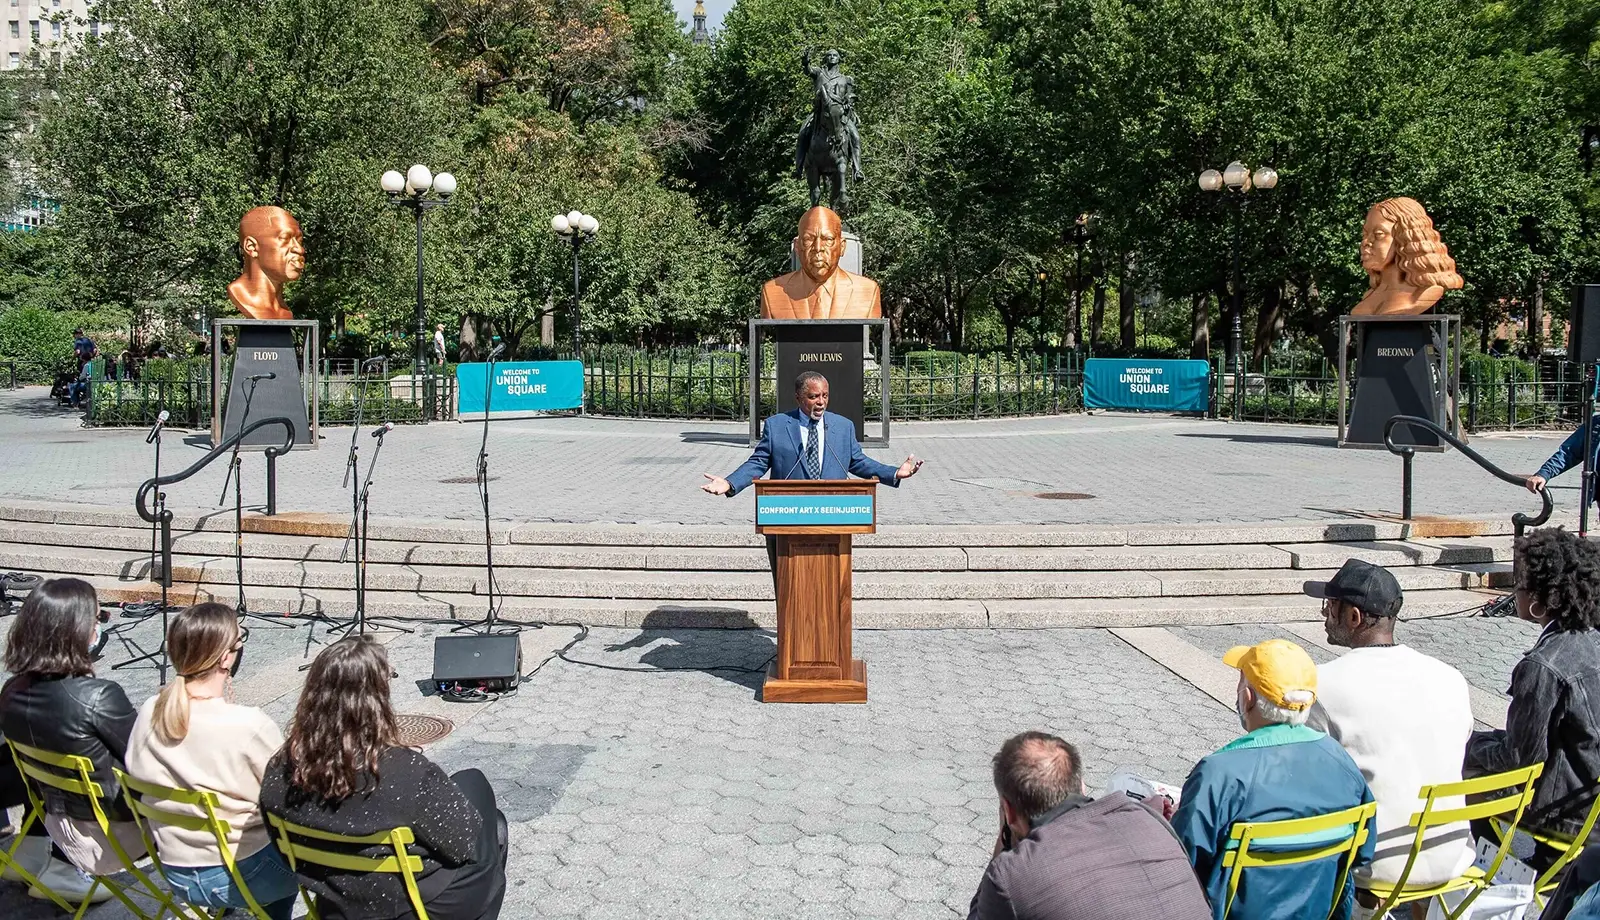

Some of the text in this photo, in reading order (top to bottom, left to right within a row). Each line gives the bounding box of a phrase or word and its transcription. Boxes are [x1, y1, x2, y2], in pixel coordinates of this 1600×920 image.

[253, 351, 278, 361] FLOYD
[1377, 347, 1415, 357] BREONNA
[799, 353, 843, 362] JOHN LEWIS
[1155, 367, 1163, 375] TO
[496, 375, 528, 386] UNION
[1119, 373, 1151, 384] UNION
[507, 384, 547, 396] SQUARE
[1130, 383, 1170, 395] SQUARE
[759, 506, 871, 514] CONFRONT ART X SEEINJUSTICE
